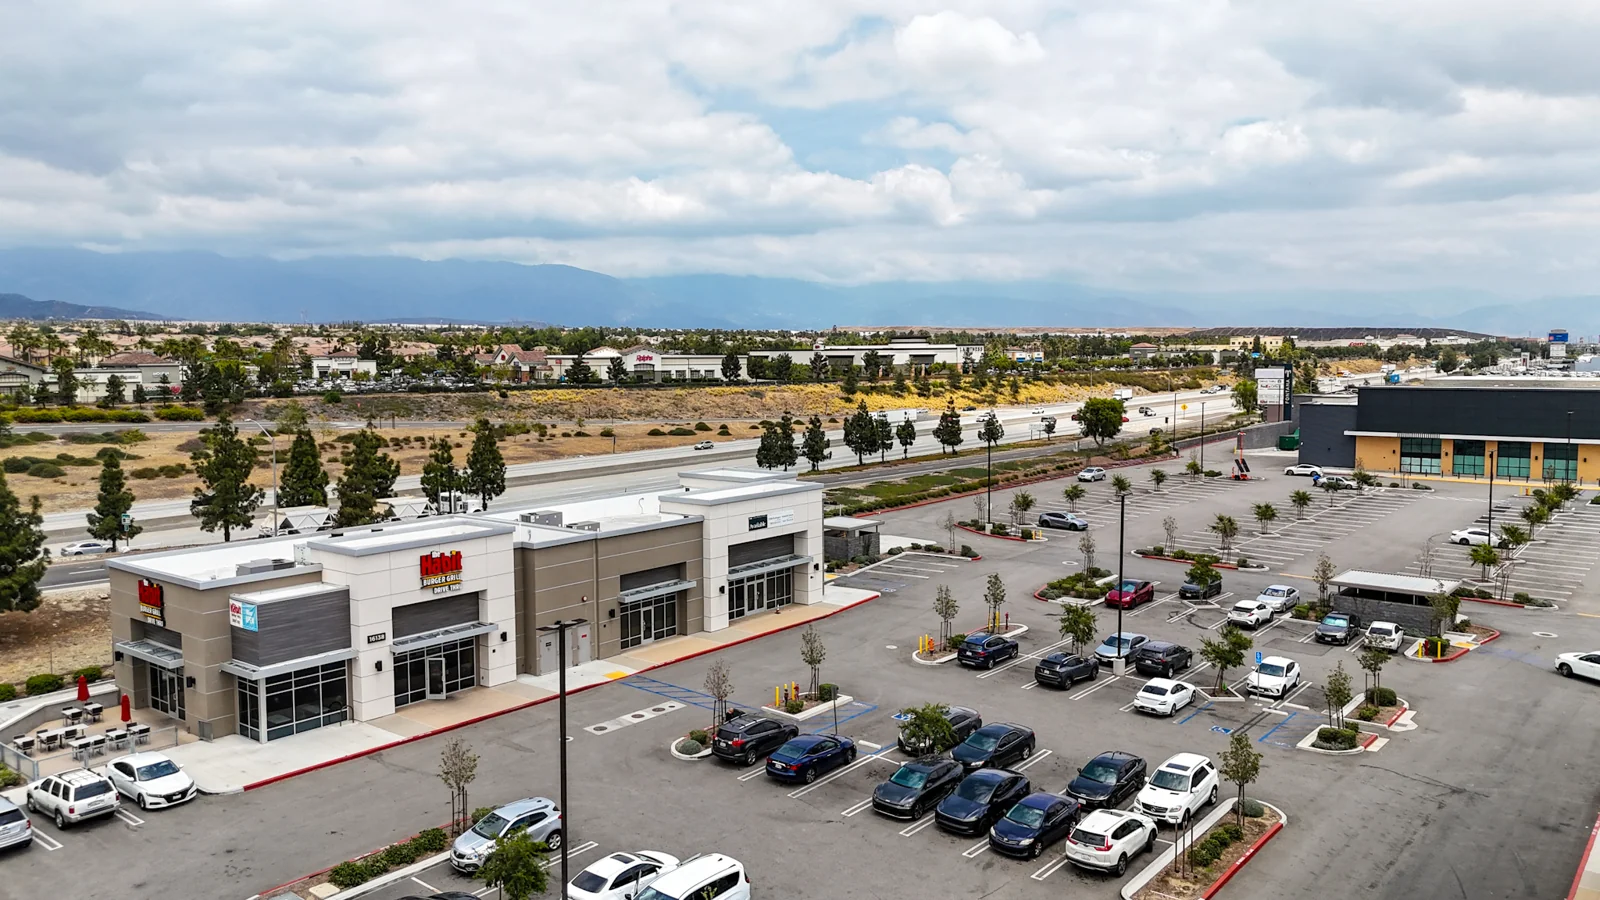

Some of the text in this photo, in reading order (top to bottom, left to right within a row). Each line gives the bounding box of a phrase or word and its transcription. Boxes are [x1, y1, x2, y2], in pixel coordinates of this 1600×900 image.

[420, 551, 462, 576] Habit
[423, 574, 461, 586] BURGER GRILL
[433, 586, 449, 594] DRIVE
[368, 634, 385, 642] 16138
